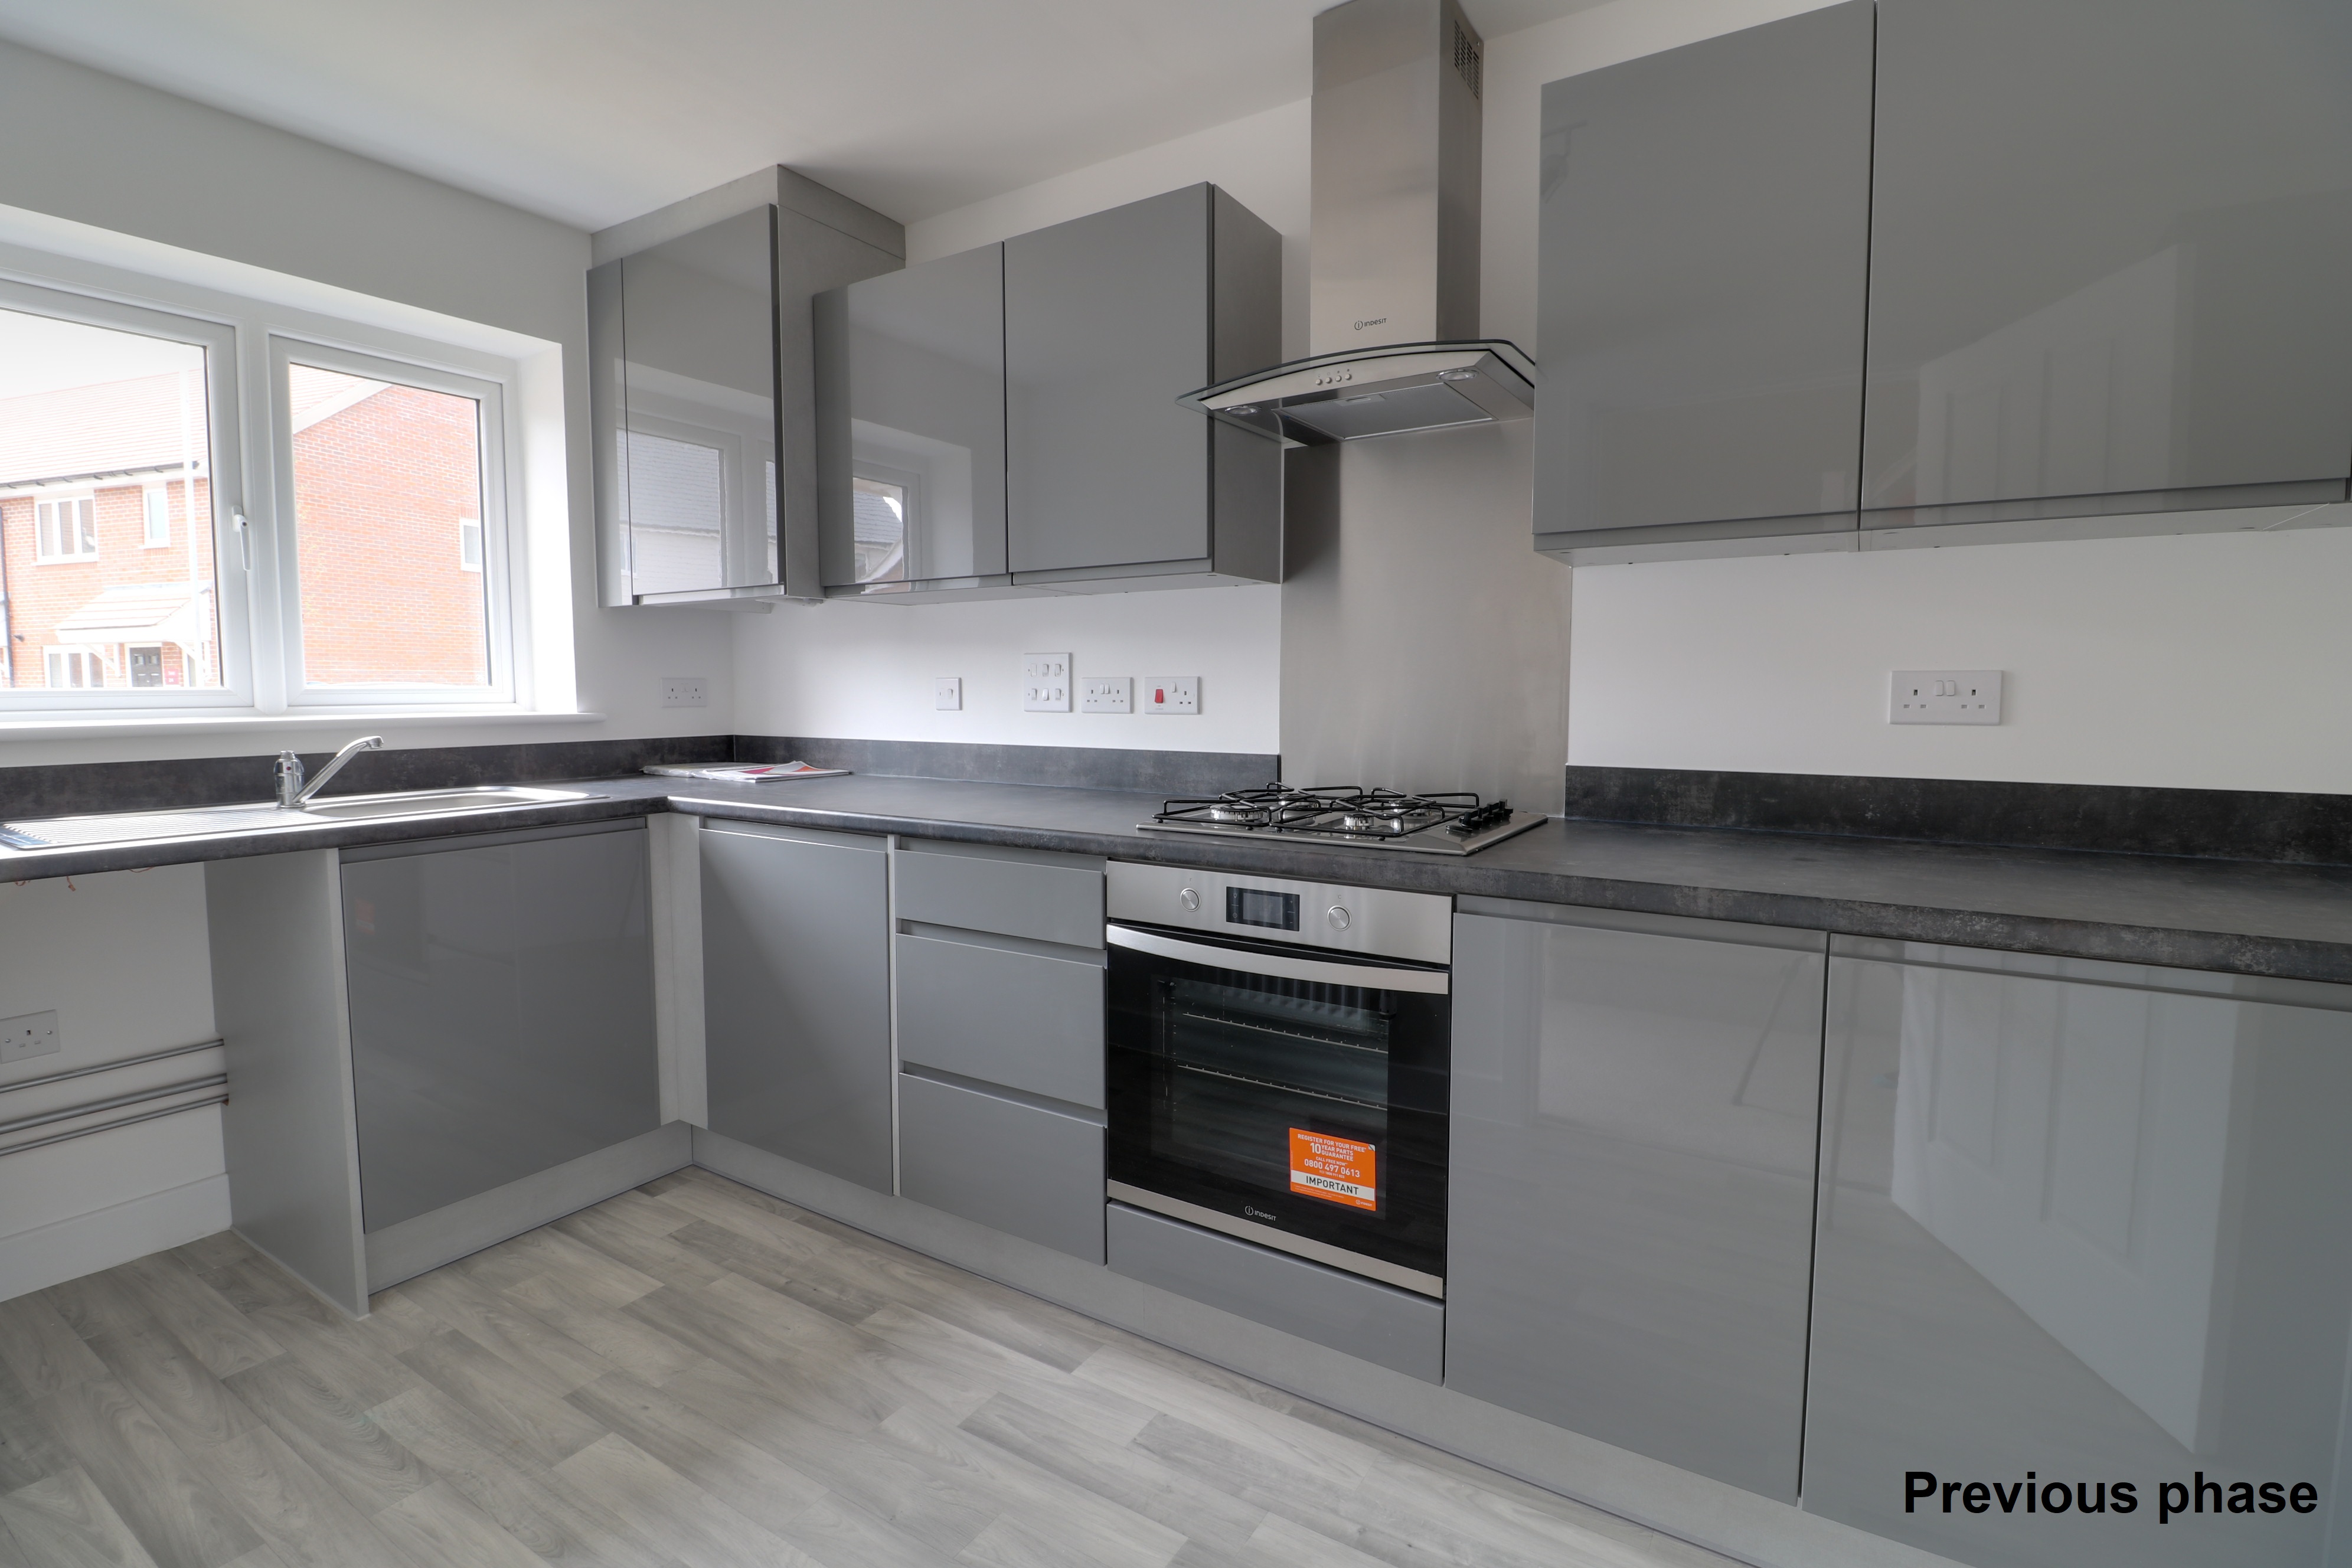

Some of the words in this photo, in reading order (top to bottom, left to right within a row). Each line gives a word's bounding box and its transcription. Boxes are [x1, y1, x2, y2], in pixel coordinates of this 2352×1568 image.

[1298, 1134, 1322, 1144] REGISTER
[1310, 1142, 1321, 1154] 10
[1321, 1151, 1353, 1161] GUARANTEE
[1304, 1158, 1322, 1169] 0800
[1325, 1164, 1339, 1172] 497
[1341, 1167, 1360, 1178] 0613
[1306, 1175, 1359, 1195] IMPORTANT
